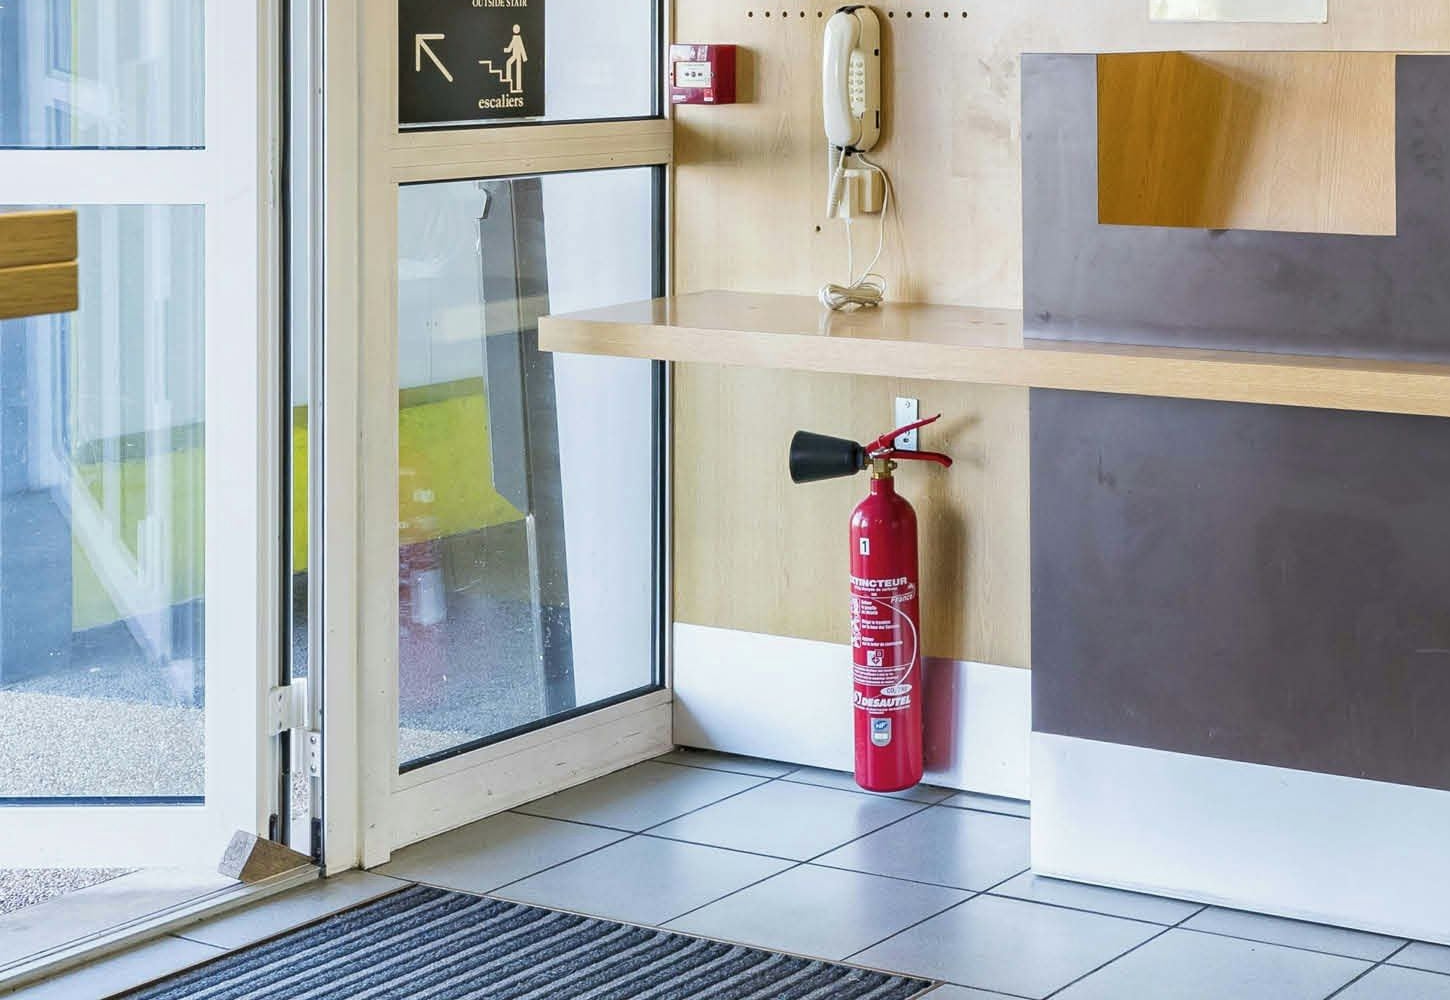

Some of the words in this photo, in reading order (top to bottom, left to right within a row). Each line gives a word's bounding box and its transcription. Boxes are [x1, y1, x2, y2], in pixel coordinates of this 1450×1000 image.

[478, 94, 524, 109] escaliers
[862, 540, 867, 552] 1
[862, 695, 911, 708] DESAUTEL
